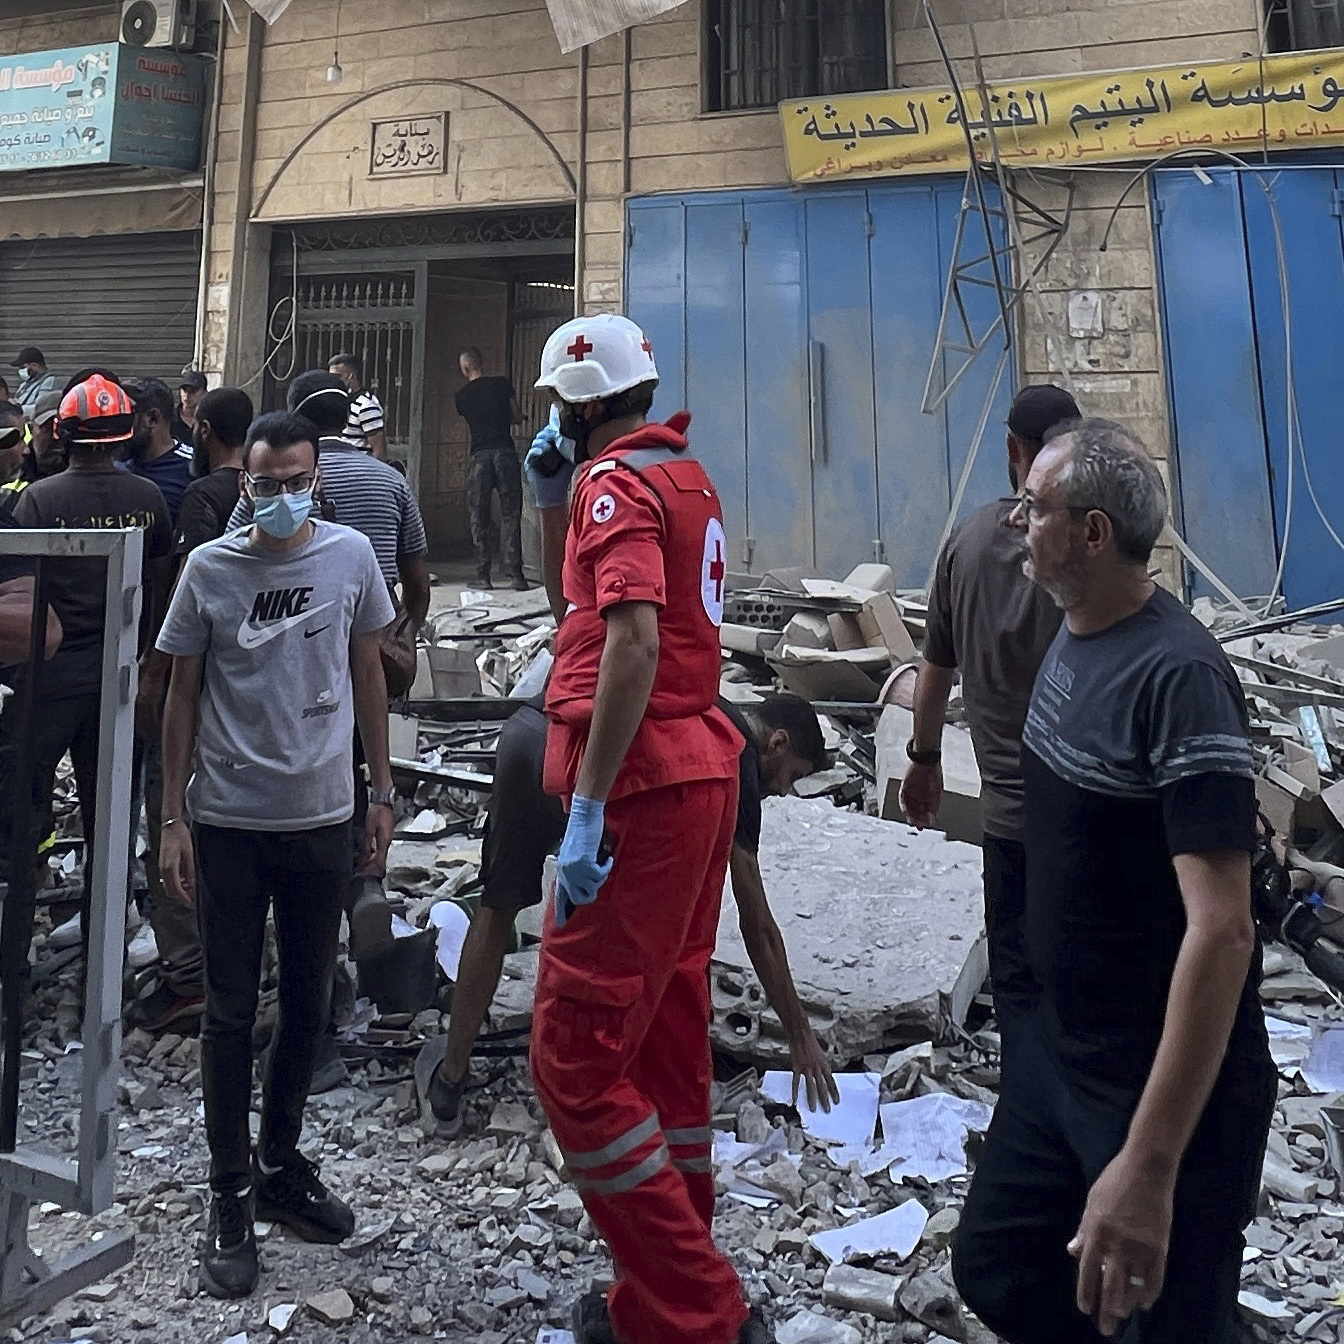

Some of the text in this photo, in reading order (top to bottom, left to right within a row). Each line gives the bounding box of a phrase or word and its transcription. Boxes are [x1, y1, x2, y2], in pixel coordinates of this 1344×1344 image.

[13, 59, 77, 92] مؤسسة
[31, 106, 62, 125] صيانة
[74, 105, 95, 124] بيع
[938, 89, 1049, 141] الفنية
[1068, 77, 1173, 138] اليتيم
[0, 112, 29, 131] جميع
[391, 122, 431, 140] بناية
[796, 100, 930, 151] الحديثة
[23, 131, 51, 146] صيانة
[1045, 135, 1105, 162] لوازم
[1128, 131, 1213, 153] صناعية
[249, 585, 314, 623] NIKE
